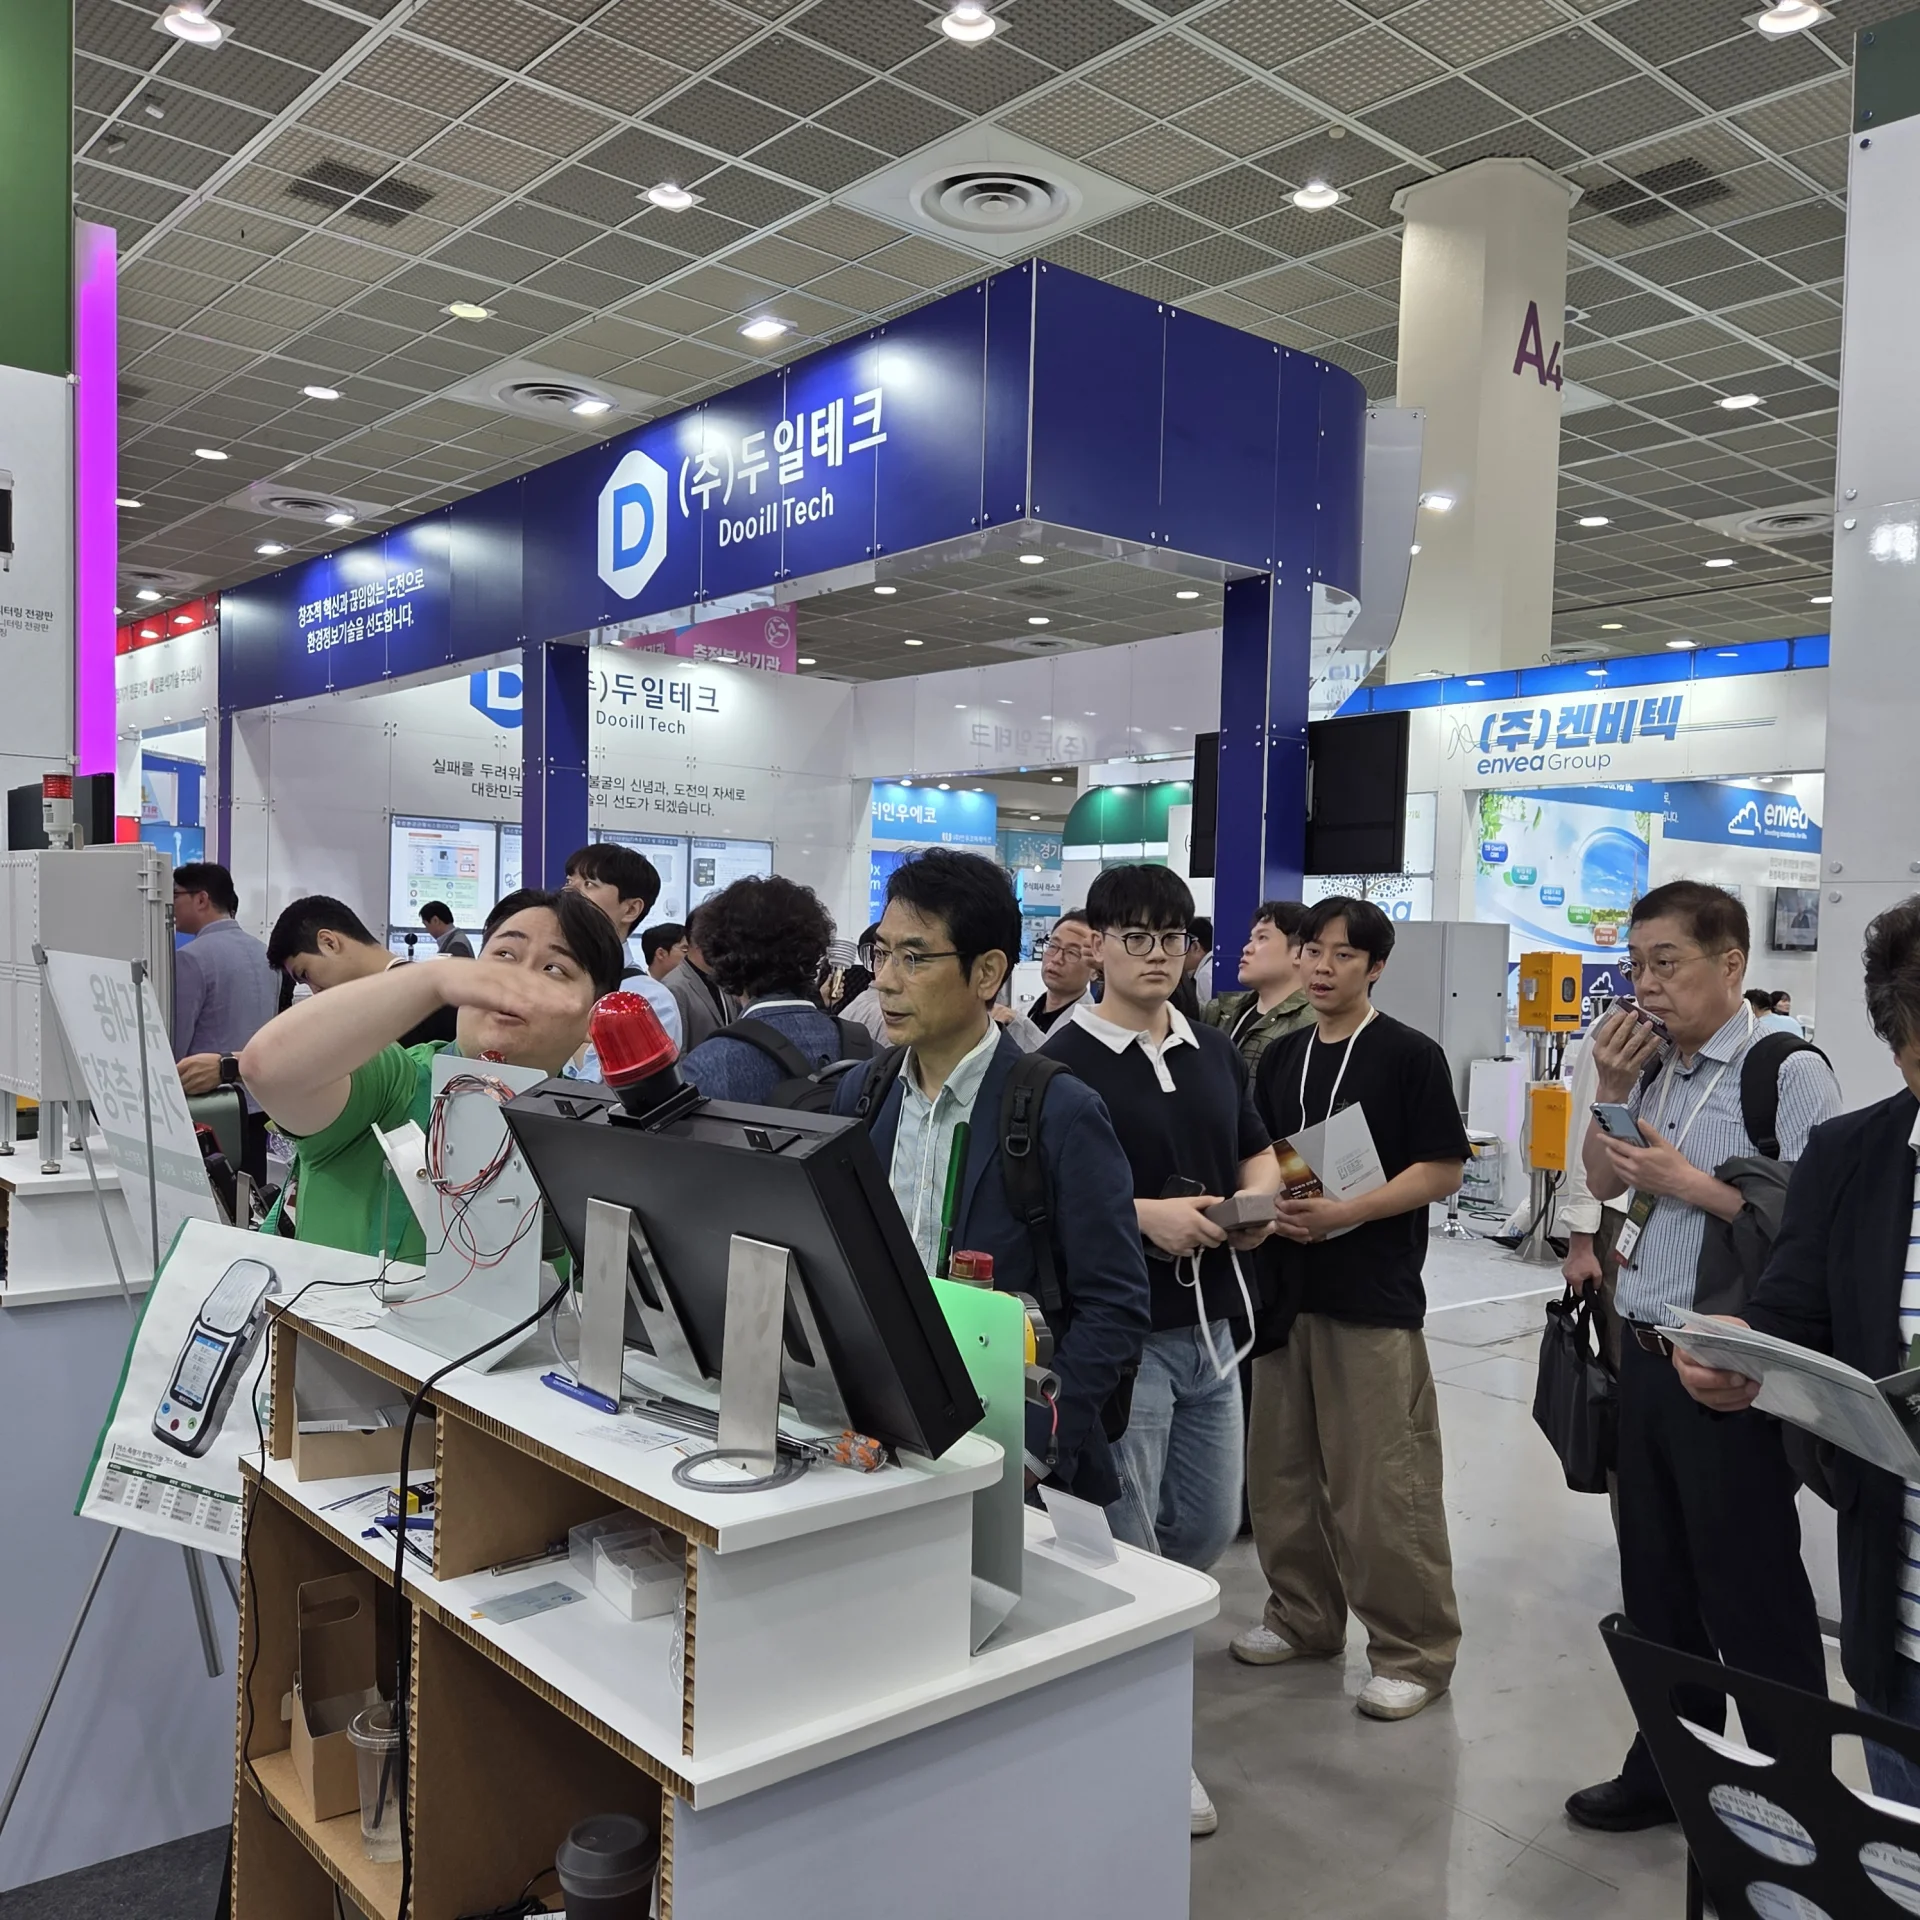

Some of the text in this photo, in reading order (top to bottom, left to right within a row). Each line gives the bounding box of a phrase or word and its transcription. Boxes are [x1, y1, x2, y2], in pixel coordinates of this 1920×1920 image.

[1513, 300, 1563, 392] A4
[679, 387, 888, 518] (주)두일테크
[719, 486, 834, 547] Dooill Tech
[298, 568, 425, 629] 창조적 혁신과 끊임없는 도전으로
[307, 601, 415, 654] 환경정보기술을 선도합니다.
[596, 710, 686, 735] Dooill Tech
[1479, 695, 1684, 754] (주)켄비텍
[432, 758, 475, 776] 실패를
[630, 778, 670, 796] 신념과,
[673, 783, 709, 800] 도전의
[712, 786, 747, 802] 자세로
[1477, 753, 1611, 775] envea Group
[612, 796, 650, 813] 선도가
[653, 799, 715, 816] 되겠습니다.
[1764, 803, 1809, 830] envea
